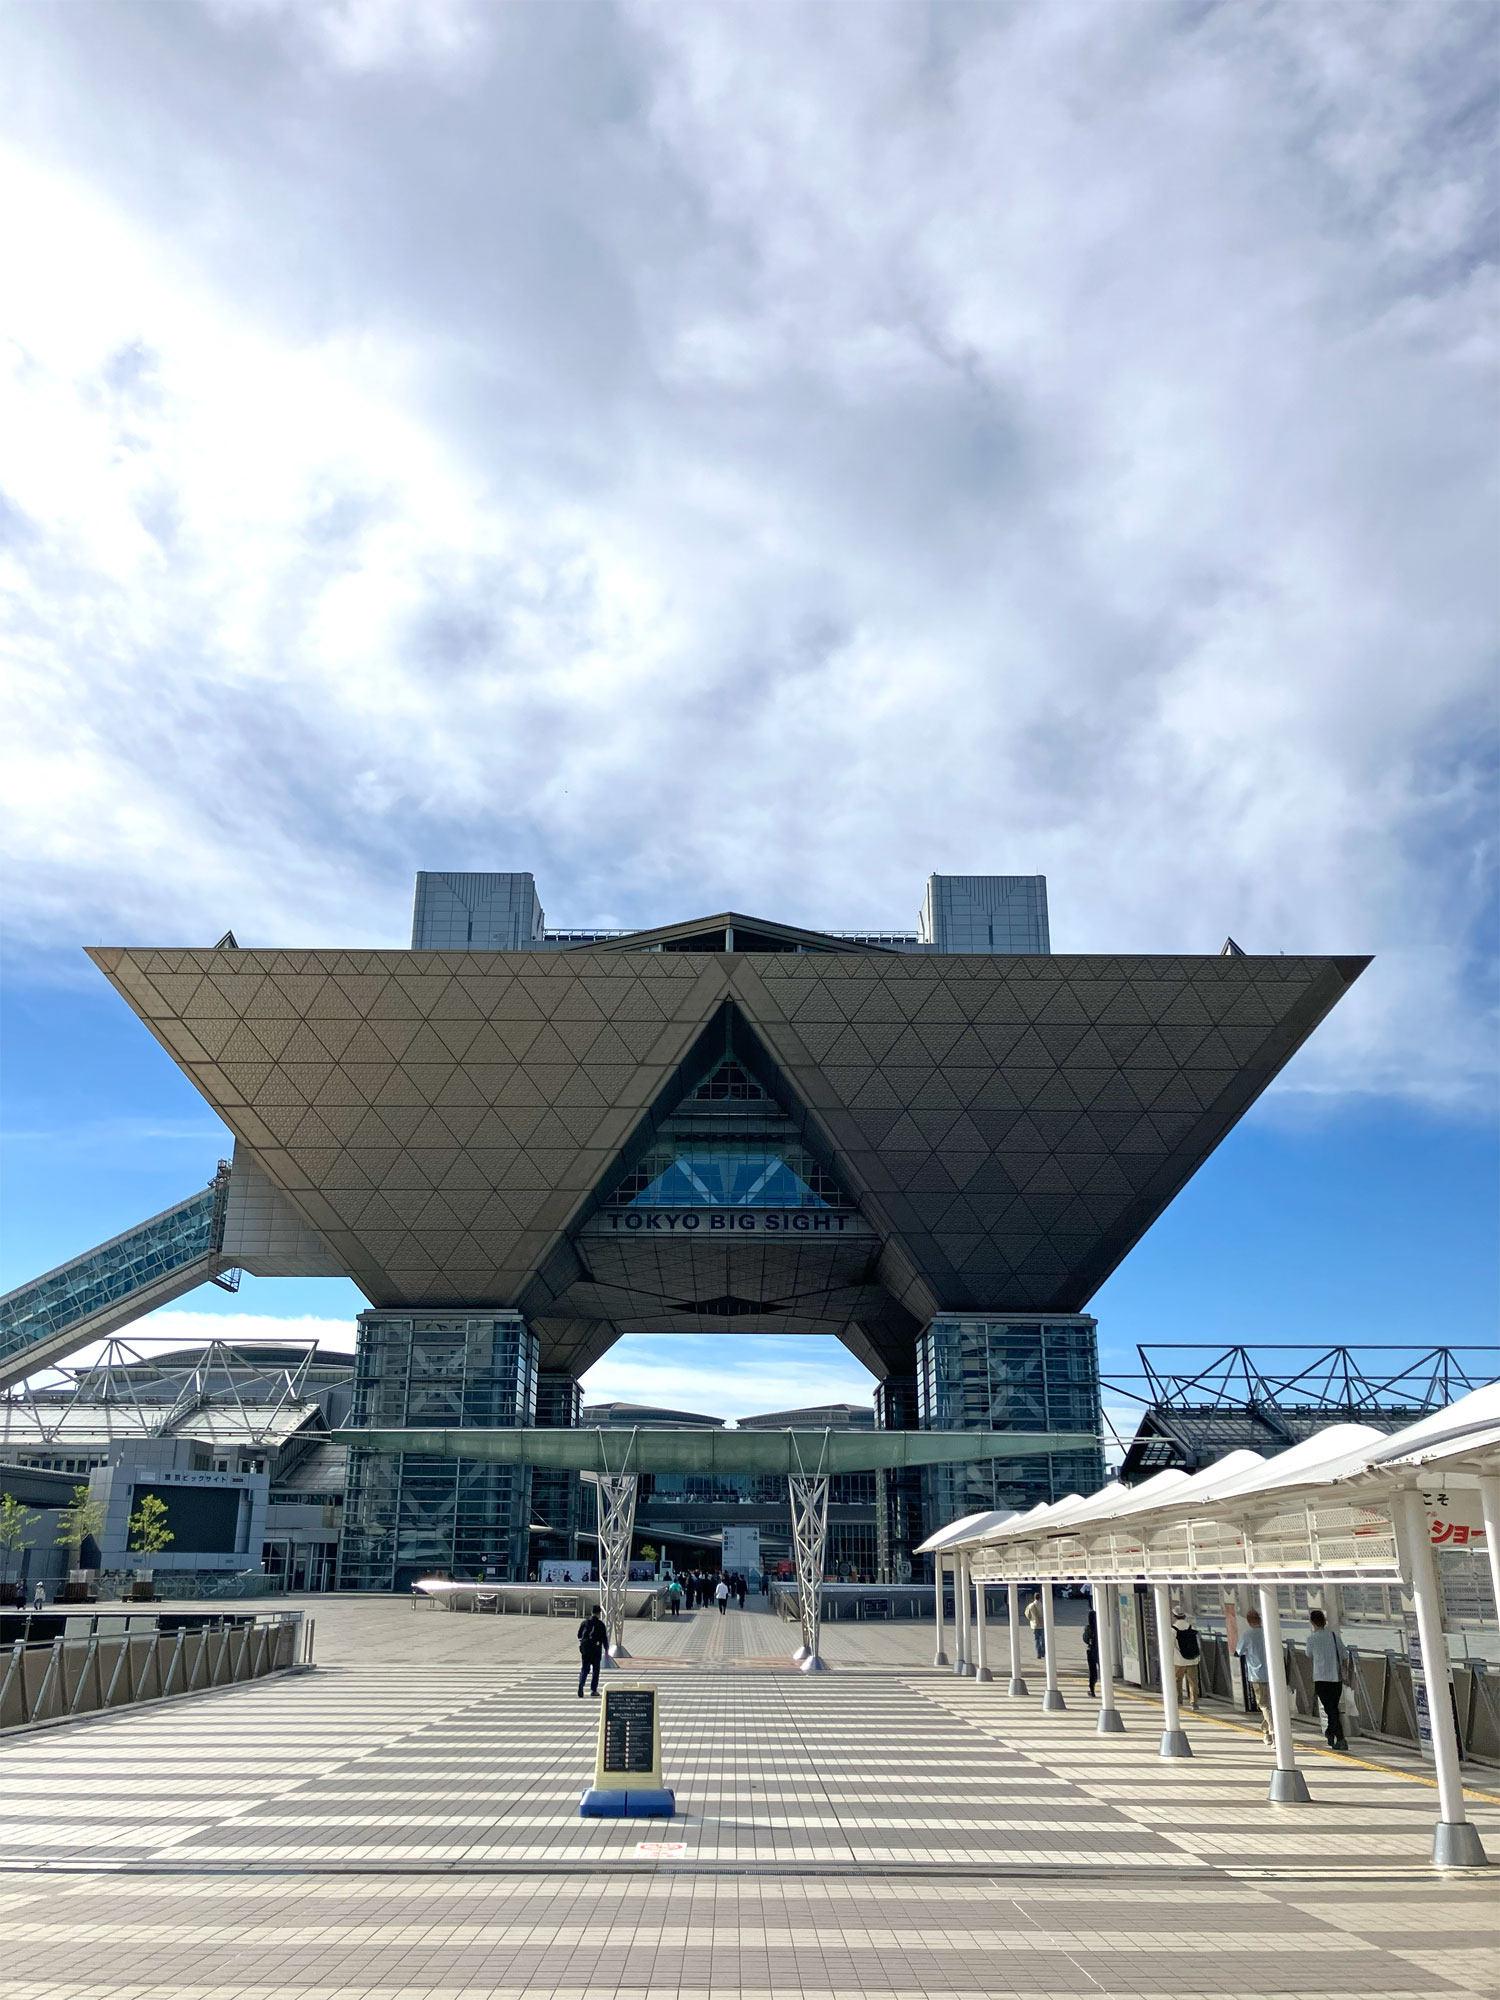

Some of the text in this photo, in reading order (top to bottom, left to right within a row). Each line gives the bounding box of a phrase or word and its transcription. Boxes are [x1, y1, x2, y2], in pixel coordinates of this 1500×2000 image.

[607, 1213, 849, 1231] TOKYO BIG SIGHT
